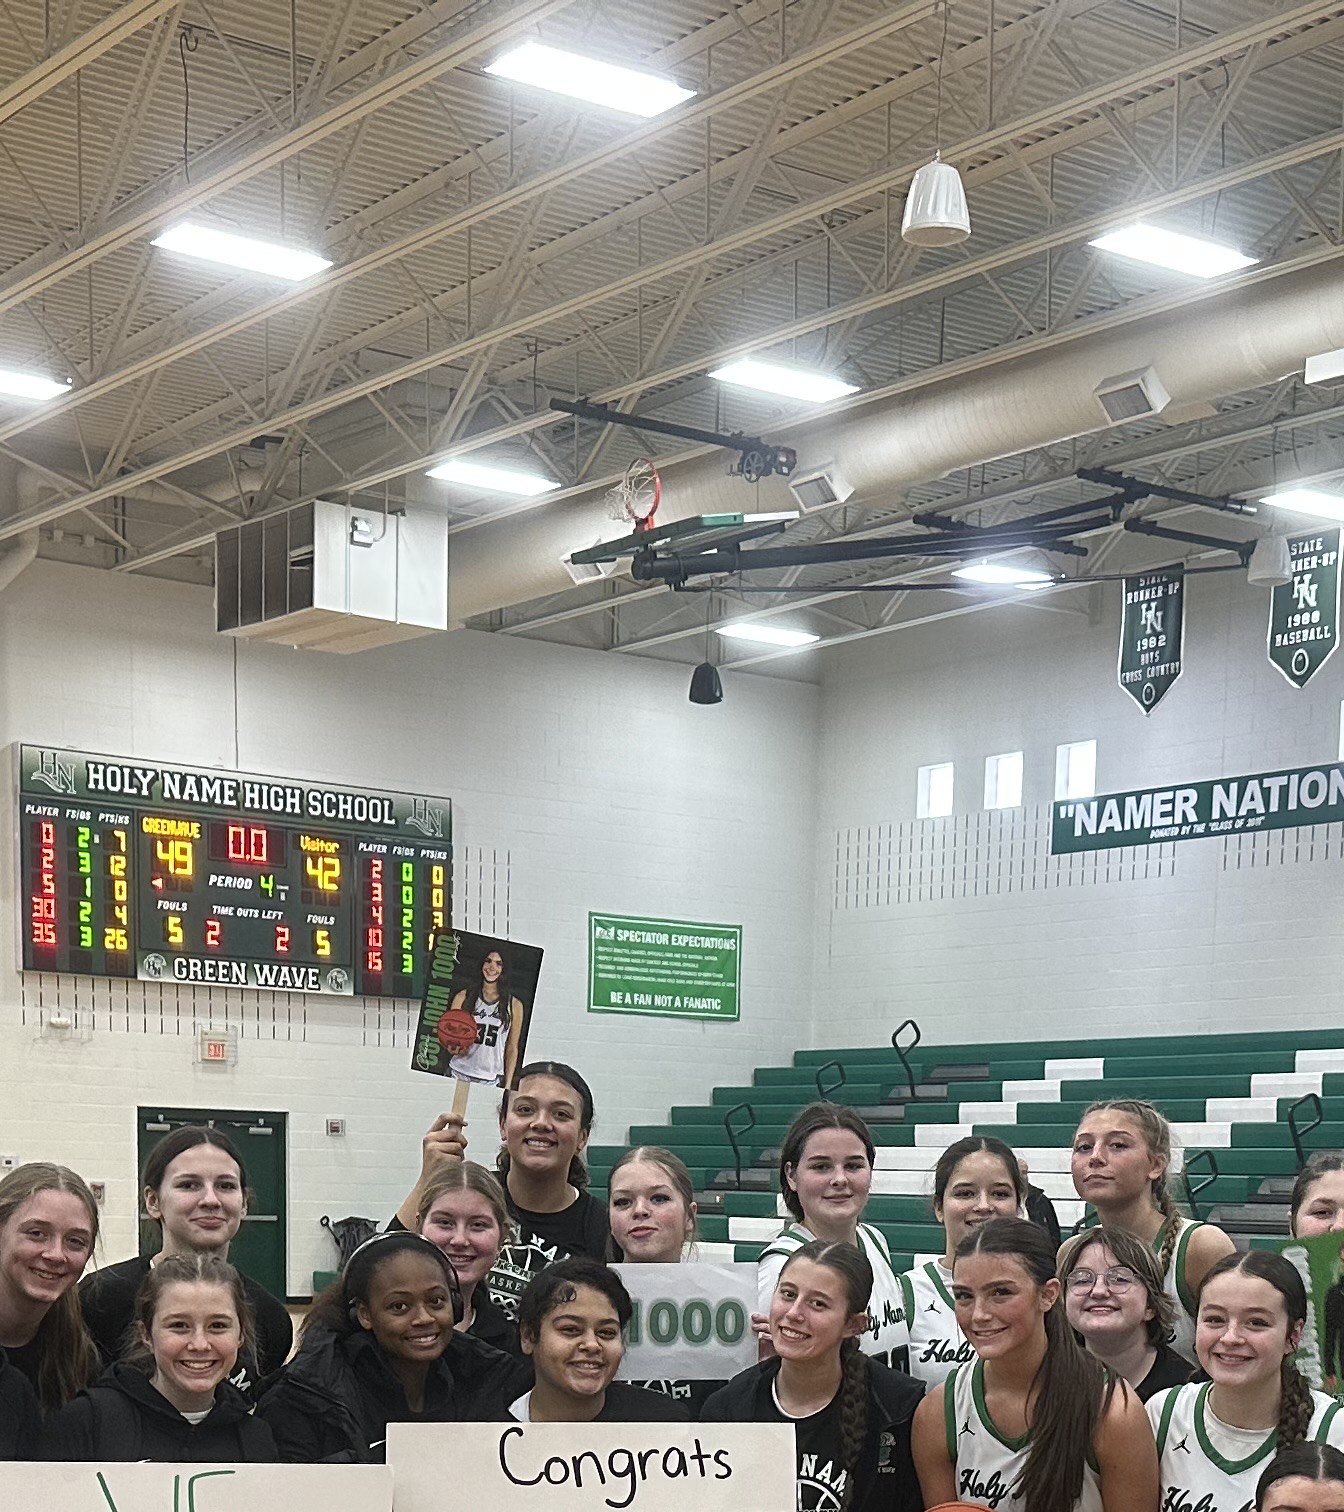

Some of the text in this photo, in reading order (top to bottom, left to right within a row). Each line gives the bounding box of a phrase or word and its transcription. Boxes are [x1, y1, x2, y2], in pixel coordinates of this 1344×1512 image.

[1291, 537, 1323, 556] STATE
[1127, 582, 1180, 604] RUNNER-UP
[1136, 635, 1167, 651] 1982
[1275, 625, 1331, 647] BASEBALL
[87, 763, 396, 825] HOLY NAME HIGH SCHOOL
[25, 804, 59, 817] PLAYER
[1059, 788, 1199, 837] "NAMER
[77, 826, 91, 848] 2
[114, 830, 126, 852] 7
[142, 817, 201, 838] GREENWAVE
[300, 835, 340, 853] Visitor
[359, 842, 387, 854] PLAYER
[42, 848, 126, 876] 2 3 12
[157, 840, 193, 875] 49
[209, 874, 253, 890] PERIOD
[307, 856, 341, 891] 42
[371, 859, 444, 885] 2 0 0
[42, 873, 127, 901] 5 1 0
[259, 874, 274, 898] 4
[371, 883, 444, 908] 3 0 0
[32, 896, 127, 926] 30 2 4
[157, 900, 188, 911] FOULS
[212, 905, 283, 921] TIME OUTS LEFT
[371, 905, 383, 925] 4
[402, 908, 413, 928] 2
[167, 916, 184, 943] 5
[307, 914, 335, 925] FOULS
[32, 922, 128, 950] 35 3 26
[206, 920, 290, 952] 2 2
[316, 930, 331, 956] 5
[368, 928, 413, 950] 10 2
[617, 929, 669, 945] SPECTATOR
[671, 934, 736, 950] EXPECTATIONS
[368, 951, 413, 973] 15 3
[432, 934, 456, 980] 1000
[174, 958, 320, 989] GREEN WAVE
[610, 991, 721, 1010] BE A FAN NOT A FANATIC
[498, 1426, 734, 1509] Congrats
[959, 1469, 1011, 1510] Holy
